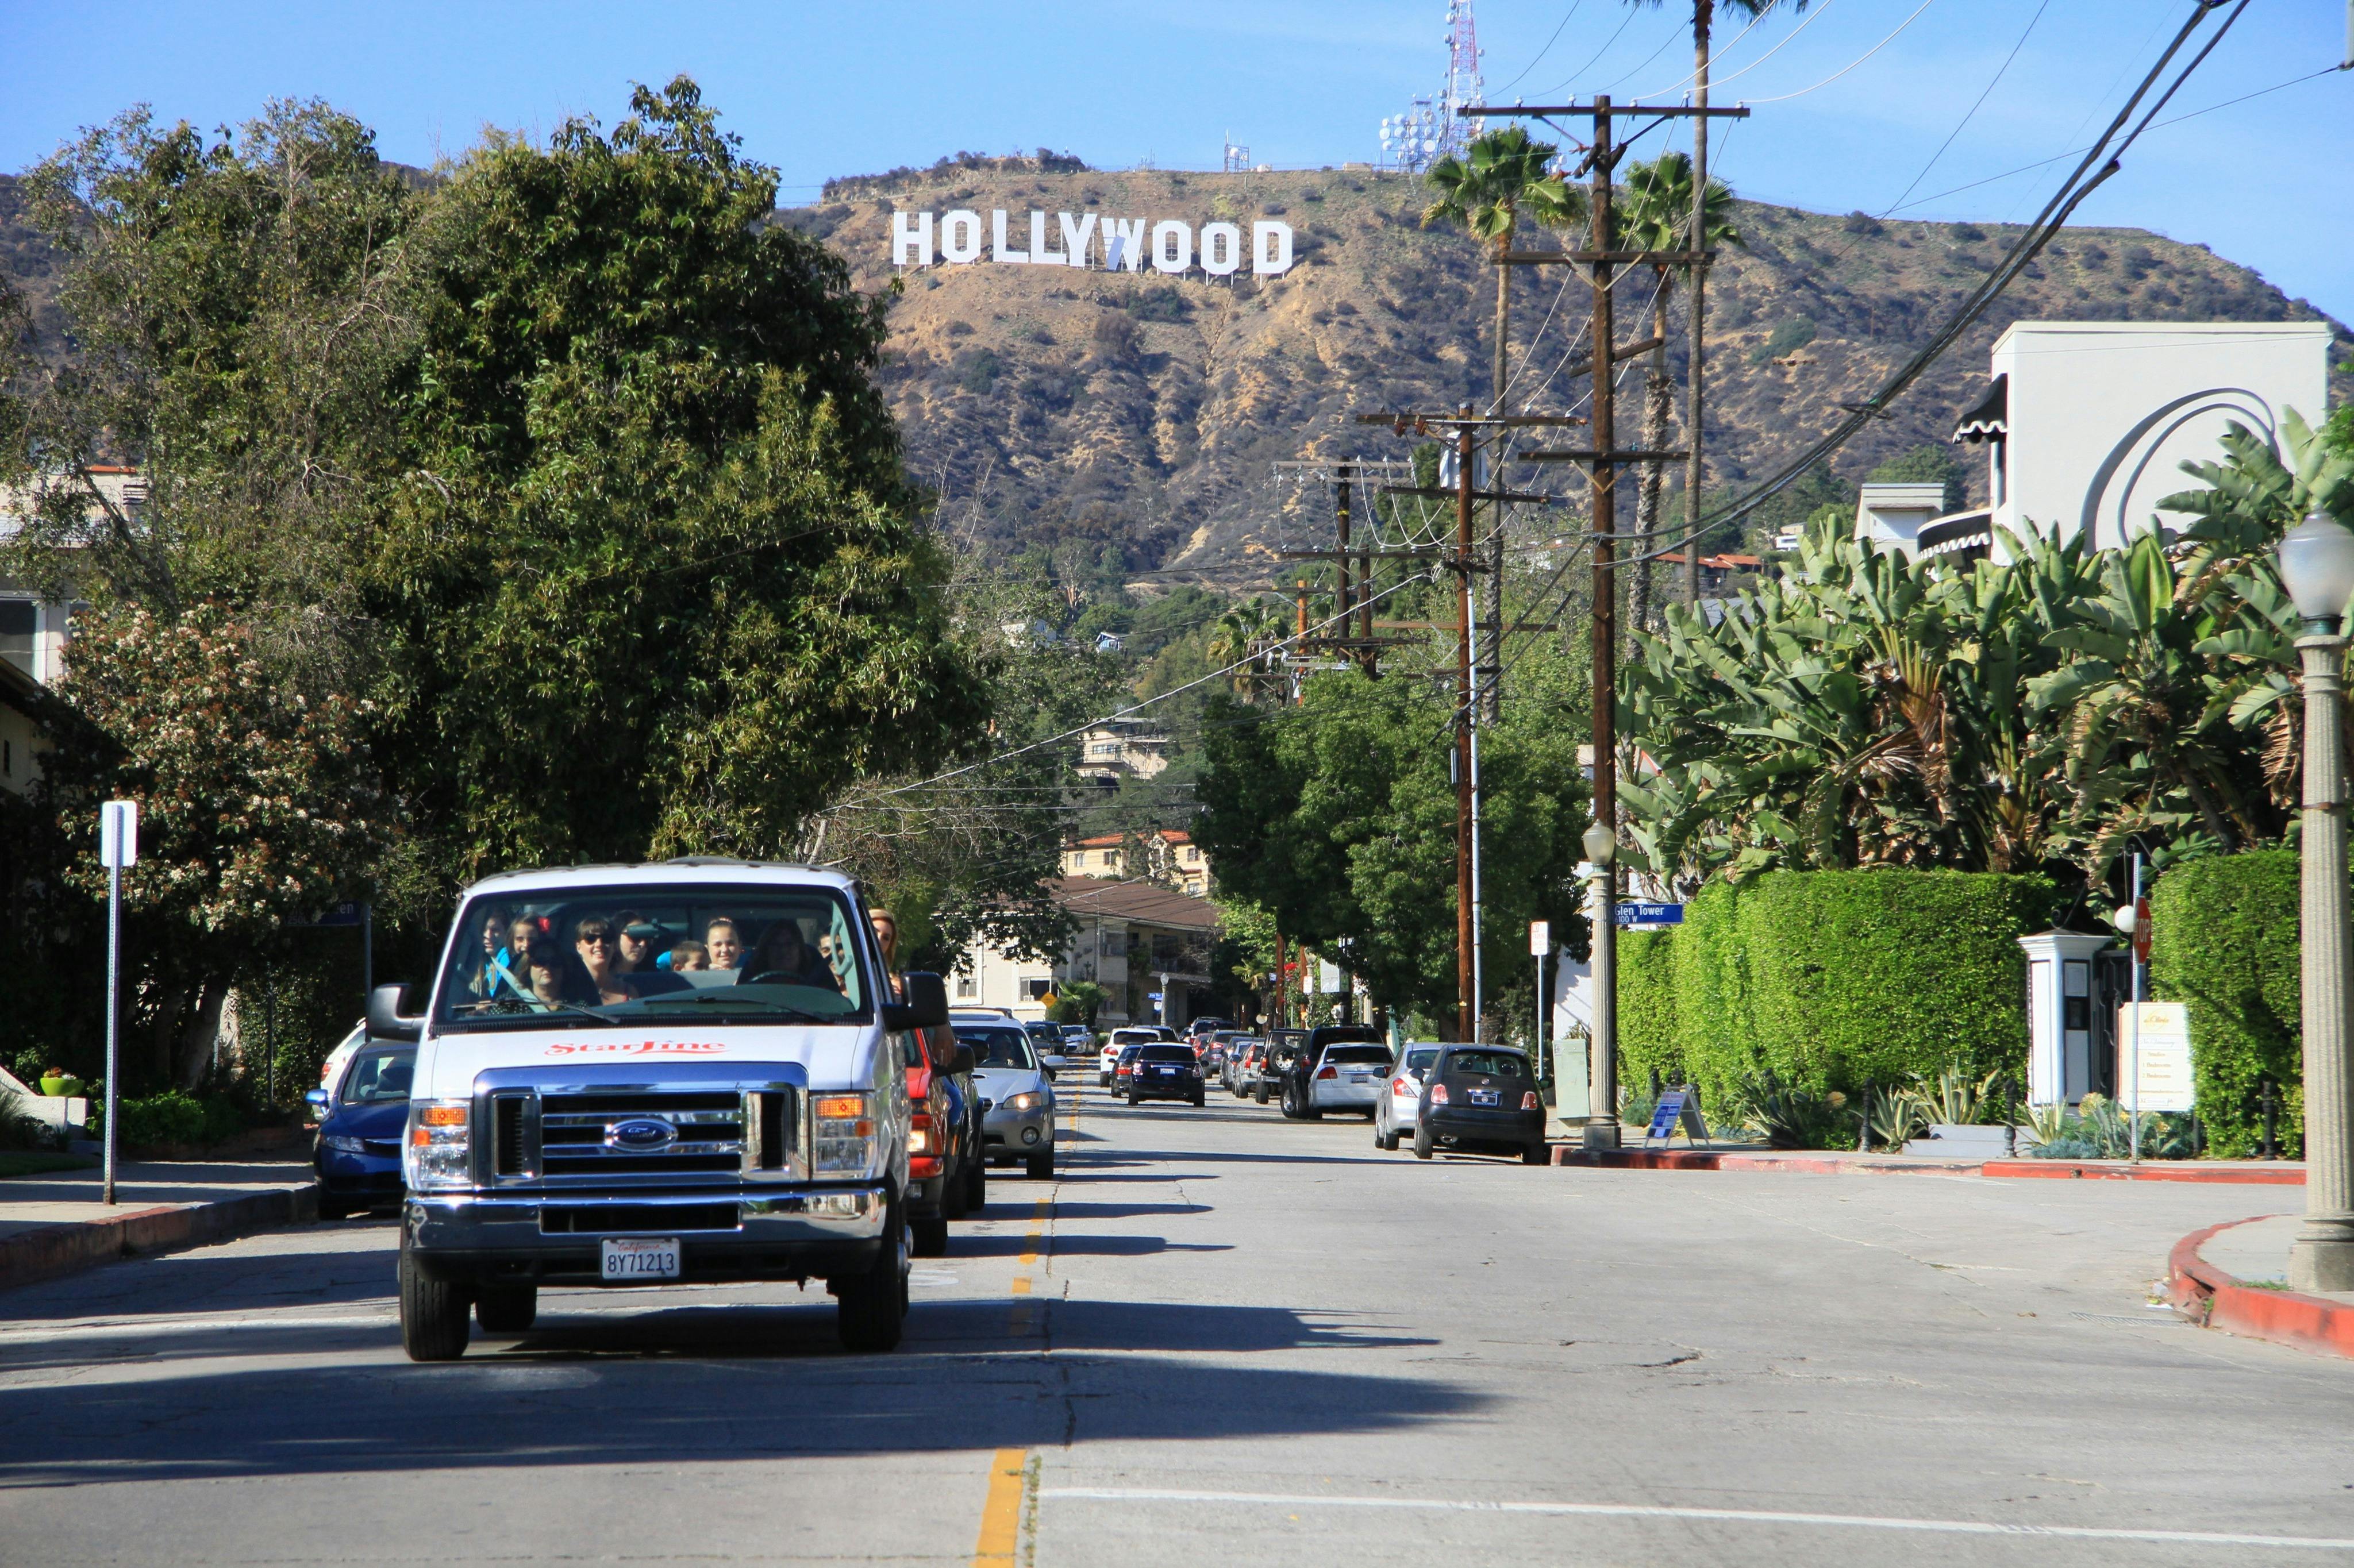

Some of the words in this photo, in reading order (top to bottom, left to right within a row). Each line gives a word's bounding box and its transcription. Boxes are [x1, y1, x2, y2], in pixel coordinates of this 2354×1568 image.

[893, 209, 1293, 275] HOLLYWOOD
[1614, 906, 1634, 916] Glen
[1638, 905, 1665, 916] Tower
[618, 1242, 661, 1253] California
[607, 1253, 674, 1273] 8Y71213
